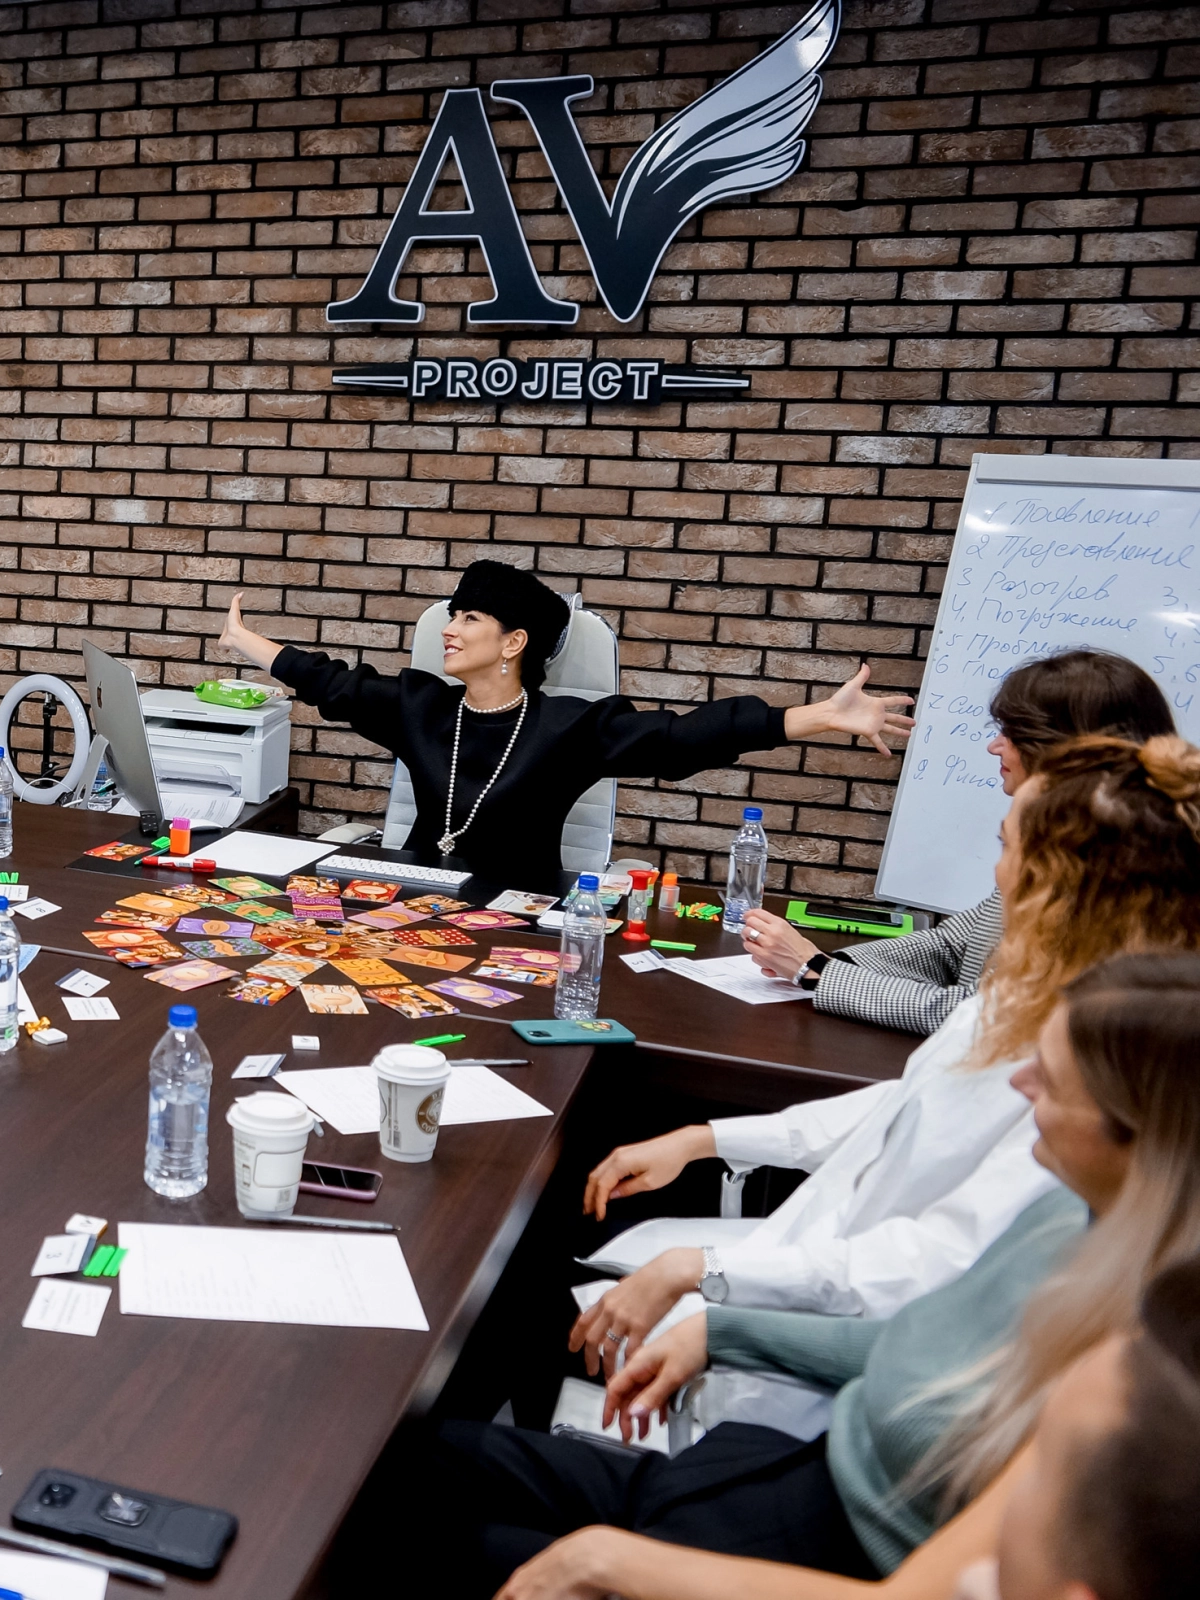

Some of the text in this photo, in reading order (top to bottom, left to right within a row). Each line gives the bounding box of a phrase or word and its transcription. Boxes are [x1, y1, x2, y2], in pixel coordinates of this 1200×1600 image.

[326, 0, 841, 324] AV
[412, 359, 659, 400] PROJECT
[966, 532, 1196, 569] 2 Представление
[957, 568, 1119, 613] 3 Разогрев
[935, 654, 949, 674] 6
[943, 754, 1000, 789] Фина
